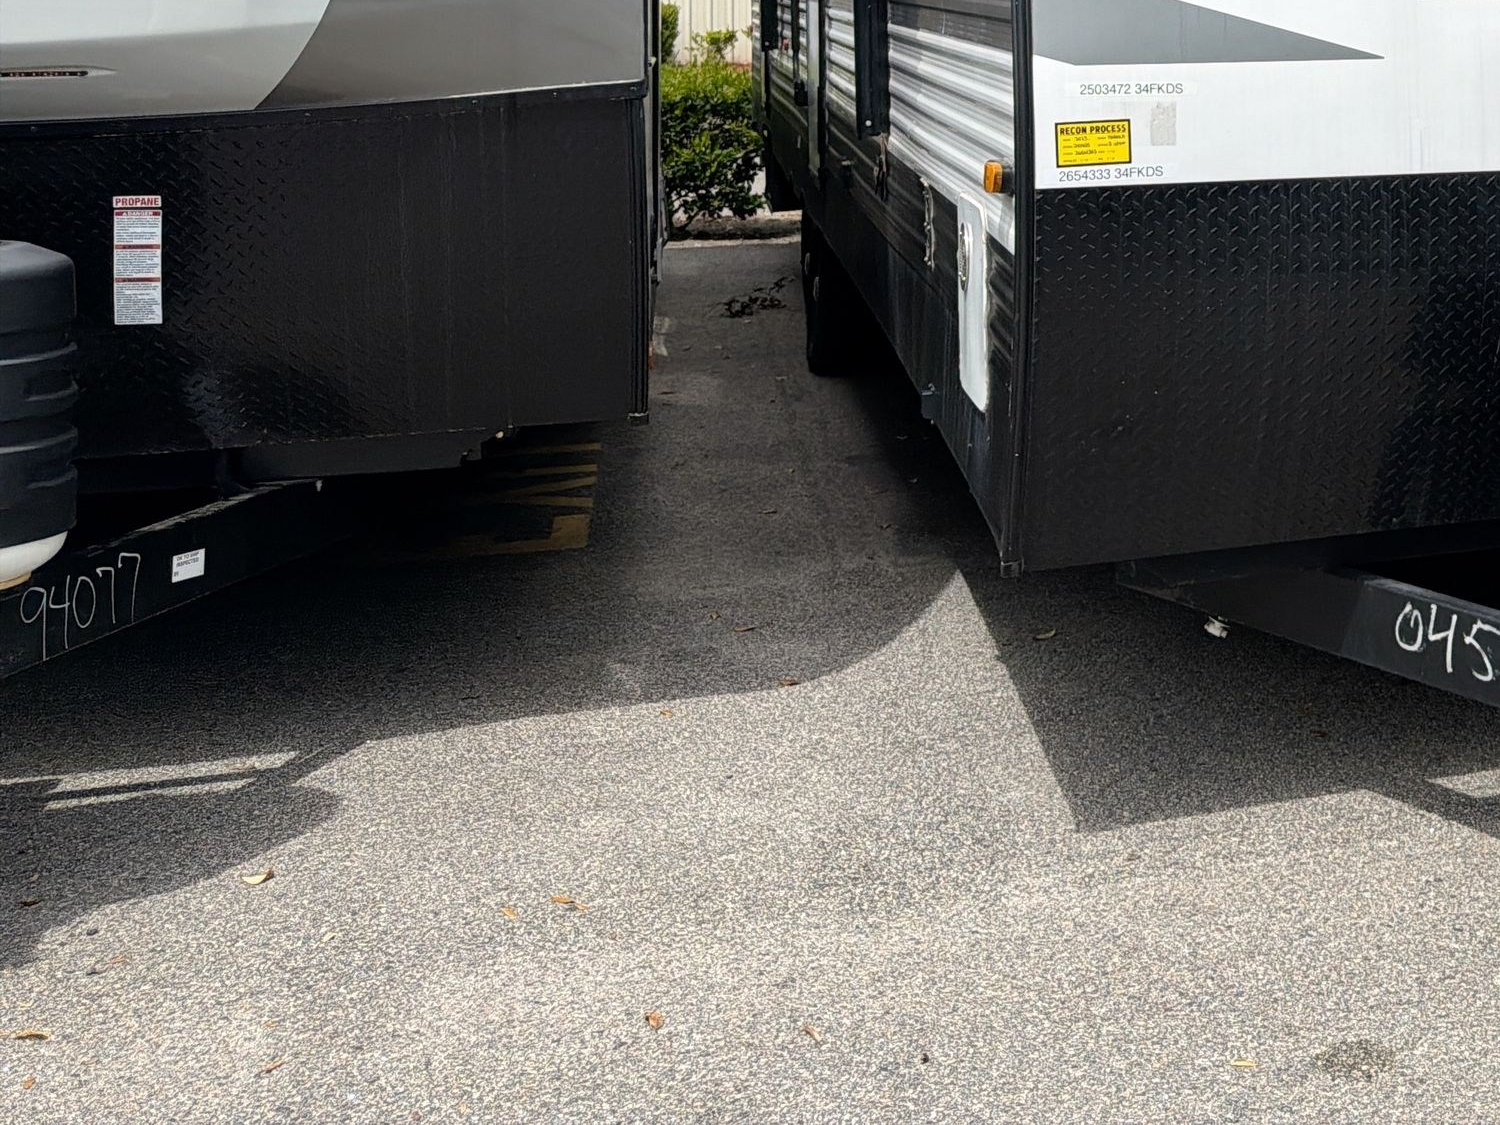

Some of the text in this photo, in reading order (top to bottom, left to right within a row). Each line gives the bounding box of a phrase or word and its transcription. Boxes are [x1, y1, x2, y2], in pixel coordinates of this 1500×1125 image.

[1080, 82, 1184, 95] 2503472 34FKDS
[1060, 124, 1126, 135] RECON PROCESS
[1059, 165, 1164, 182] 2654333 34FKDS
[115, 197, 159, 206] PROPANE
[20, 552, 141, 661] 94077
